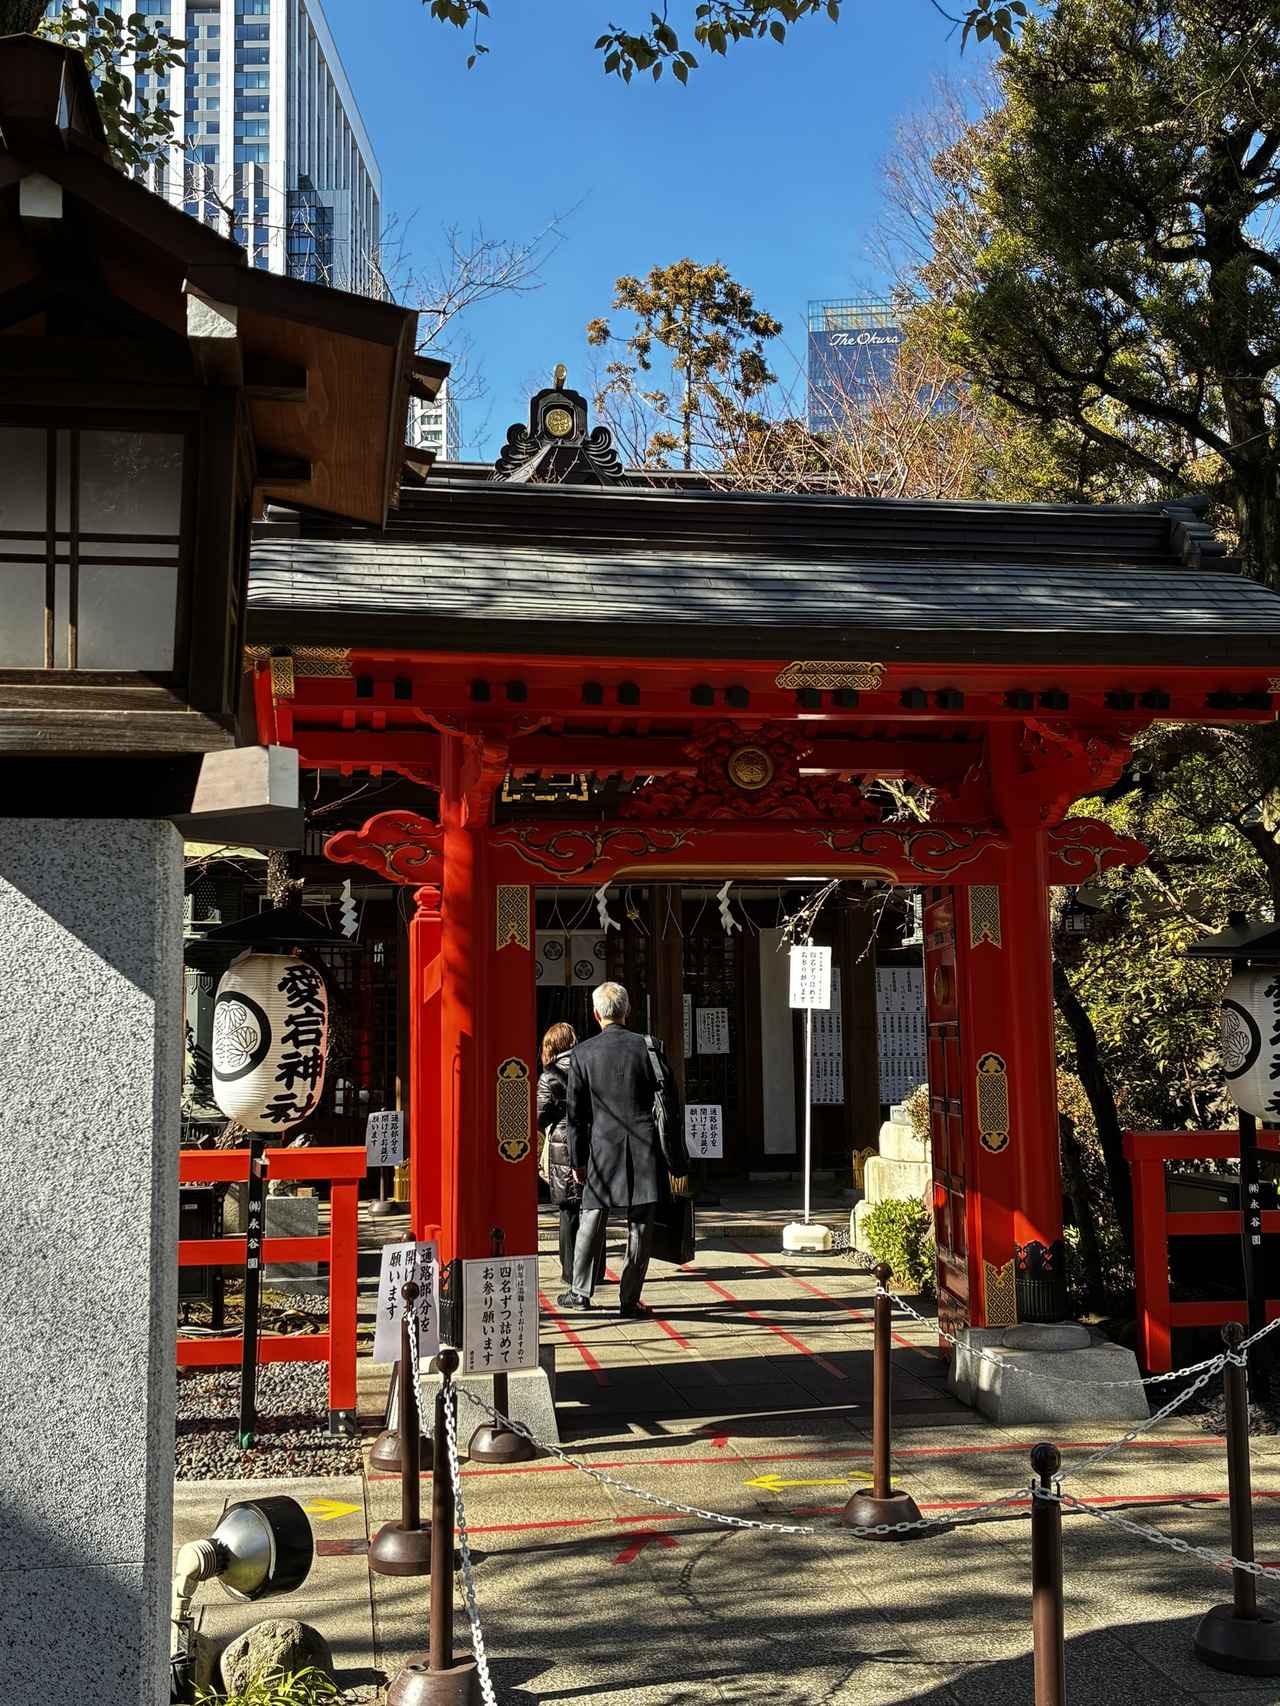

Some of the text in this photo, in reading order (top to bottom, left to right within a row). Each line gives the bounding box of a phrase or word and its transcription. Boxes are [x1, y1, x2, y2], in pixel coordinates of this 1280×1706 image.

[830, 331, 900, 346] The Okura
[260, 963, 325, 1123] 愛宕神社
[386, 1250, 402, 1321] 願います
[419, 1247, 434, 1332] 通路部分を
[482, 1266, 495, 1366] お参り願います
[499, 1265, 512, 1364] 四名ずつ詰めて
